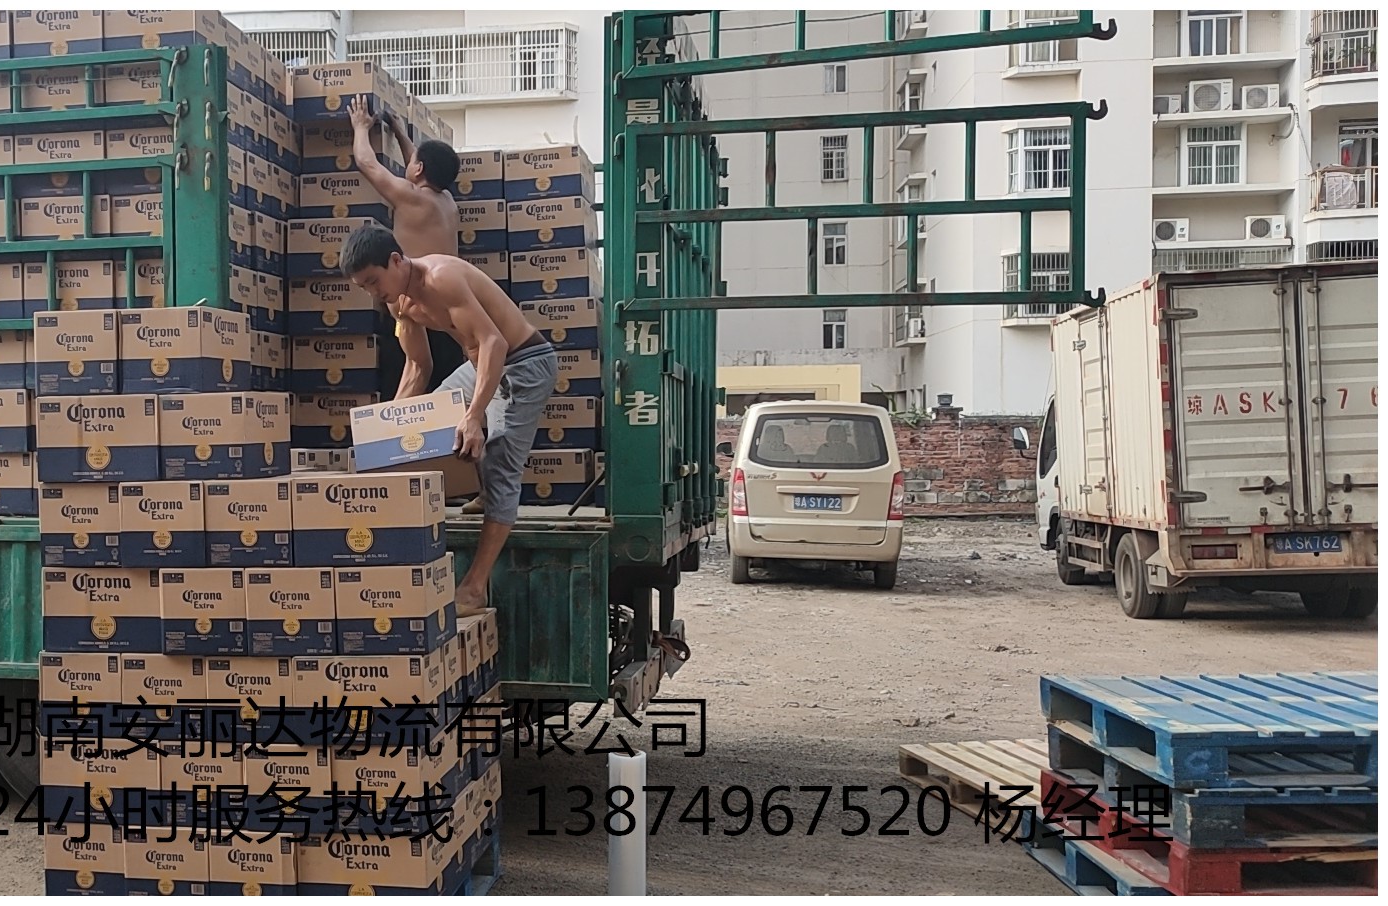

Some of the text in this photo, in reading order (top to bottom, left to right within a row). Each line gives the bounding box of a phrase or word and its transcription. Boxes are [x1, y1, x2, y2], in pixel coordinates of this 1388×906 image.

[36, 10, 79, 27] Corona
[140, 15, 163, 24] Extra
[48, 22, 71, 31] Extra
[313, 68, 351, 81] Corona
[323, 79, 344, 87] Extra
[37, 137, 80, 155] Corona
[50, 150, 72, 159] Extra
[523, 153, 560, 167] Corona
[534, 162, 553, 170] Extra
[321, 177, 360, 191] Corona
[332, 188, 352, 196] Extra
[458, 205, 486, 215] orona
[526, 204, 562, 216] Corona
[460, 215, 479, 223] Extra
[309, 223, 350, 237] Corona
[320, 234, 342, 243] Extra
[530, 255, 566, 267] Corona
[540, 264, 559, 272] Extra
[310, 282, 350, 295] Corona
[321, 293, 342, 301] Extra
[538, 304, 575, 318] Corona
[549, 313, 568, 321] Extra
[214, 316, 238, 334] Corona
[56, 333, 94, 350] Corona
[137, 326, 180, 345] Corona
[221, 332, 234, 346] Extra
[67, 344, 86, 352] Extra
[149, 338, 172, 347] Extra
[313, 339, 354, 353] Corona
[325, 351, 346, 359] Extra
[256, 400, 278, 420] Corona
[545, 401, 575, 411] orona
[67, 403, 125, 427] Corona
[380, 402, 434, 425] Corona
[396, 414, 425, 426] Extra
[84, 420, 114, 432] Extra
[182, 416, 221, 433] Corona
[262, 417, 274, 428] Extra
[193, 427, 214, 435] Extra
[523, 455, 563, 469] Corona
[533, 466, 554, 474] Extra
[325, 484, 389, 508] Corona
[61, 505, 99, 522] Corona
[139, 498, 183, 518] Corona
[228, 502, 267, 519] Corona
[344, 501, 376, 513] Extra
[151, 511, 174, 520] Extra
[239, 513, 259, 521] Extra
[72, 573, 131, 597] Corona
[89, 590, 119, 602] Extra
[182, 590, 222, 607] Corona
[269, 590, 310, 608] Corona
[360, 589, 401, 605] Corona
[194, 601, 214, 609] Extra
[281, 602, 302, 610] Extra
[372, 600, 393, 608] Extra
[58, 669, 101, 688] Corona
[325, 662, 389, 686] Corona
[70, 681, 92, 691] Extra
[143, 676, 182, 693] Corona
[225, 673, 271, 691] Corona
[343, 679, 376, 692] Extra
[155, 687, 175, 695] Extra
[239, 686, 262, 695] Extra
[87, 760, 116, 773] Extra
[183, 762, 222, 779] Corona
[264, 762, 310, 780] Corona
[194, 773, 215, 782] Extra
[276, 774, 302, 787] Extra
[355, 767, 396, 785] Corona
[367, 778, 391, 789] Extra
[62, 835, 106, 854] Corona
[328, 836, 390, 863] Corona
[75, 851, 97, 861] Extra
[146, 850, 184, 868] Corona
[228, 849, 273, 867] Corona
[157, 861, 176, 870] Extra
[241, 862, 264, 872] Extra
[346, 857, 378, 870] Extra
